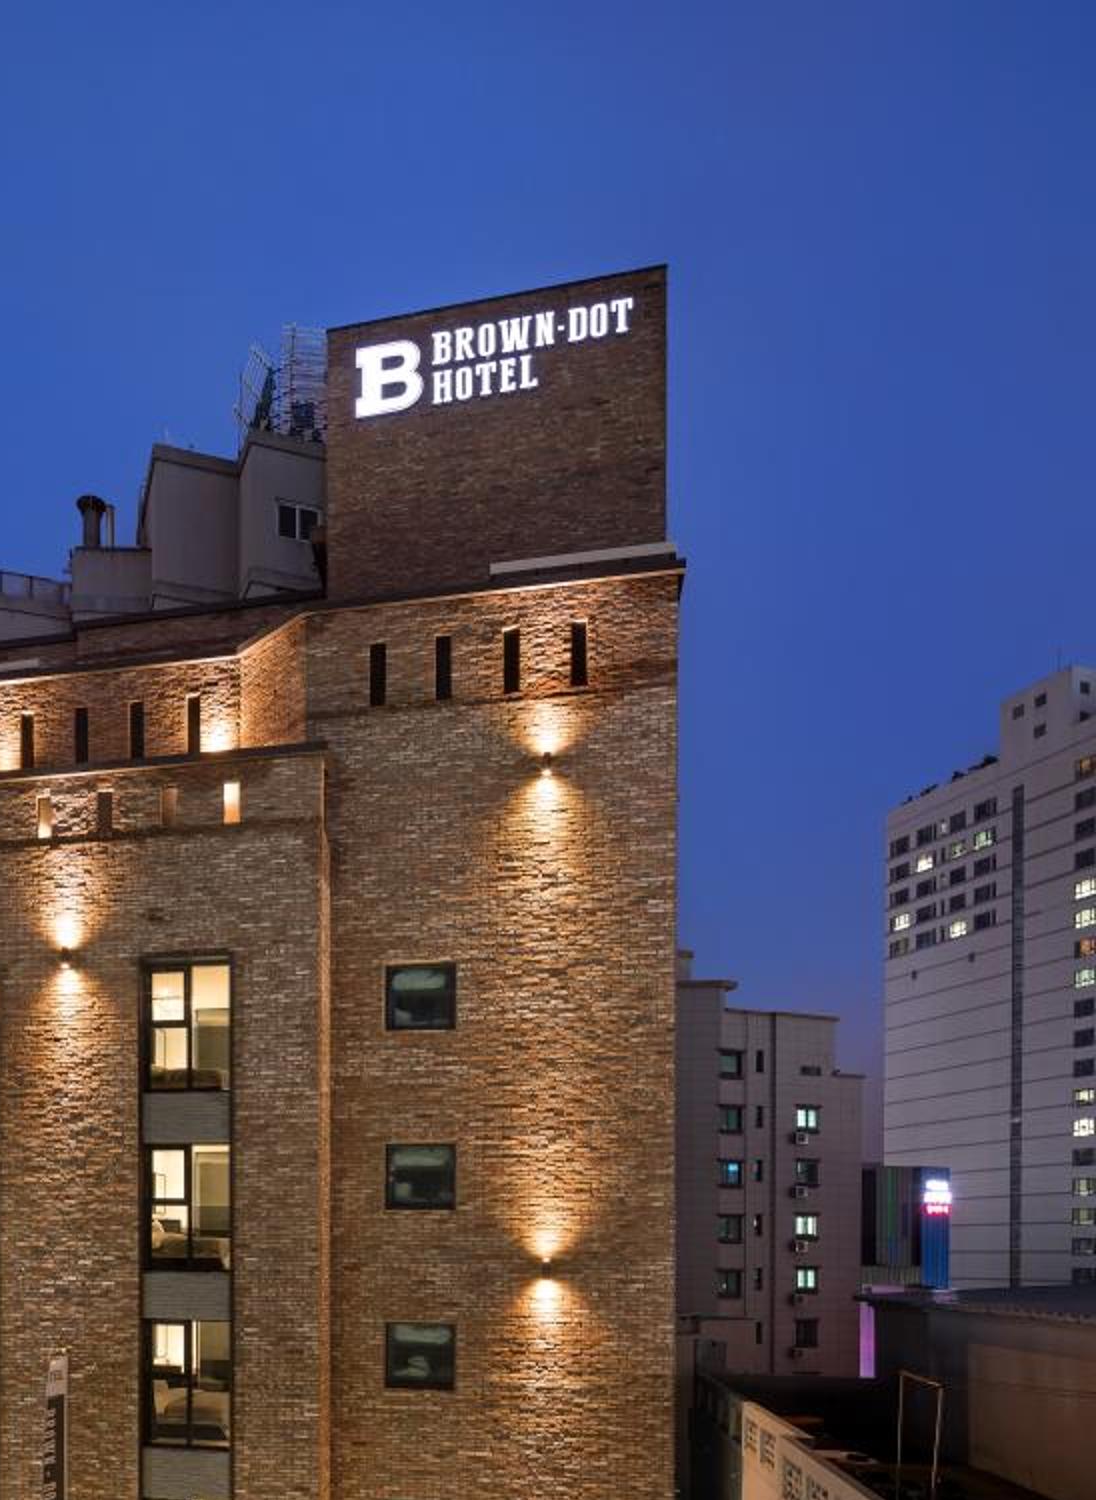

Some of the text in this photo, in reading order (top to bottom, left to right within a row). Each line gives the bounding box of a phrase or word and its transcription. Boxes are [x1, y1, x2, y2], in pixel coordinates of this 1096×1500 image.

[431, 297, 634, 367] BROWN-DOT
[355, 339, 424, 419] B
[431, 355, 539, 404] HOTEL
